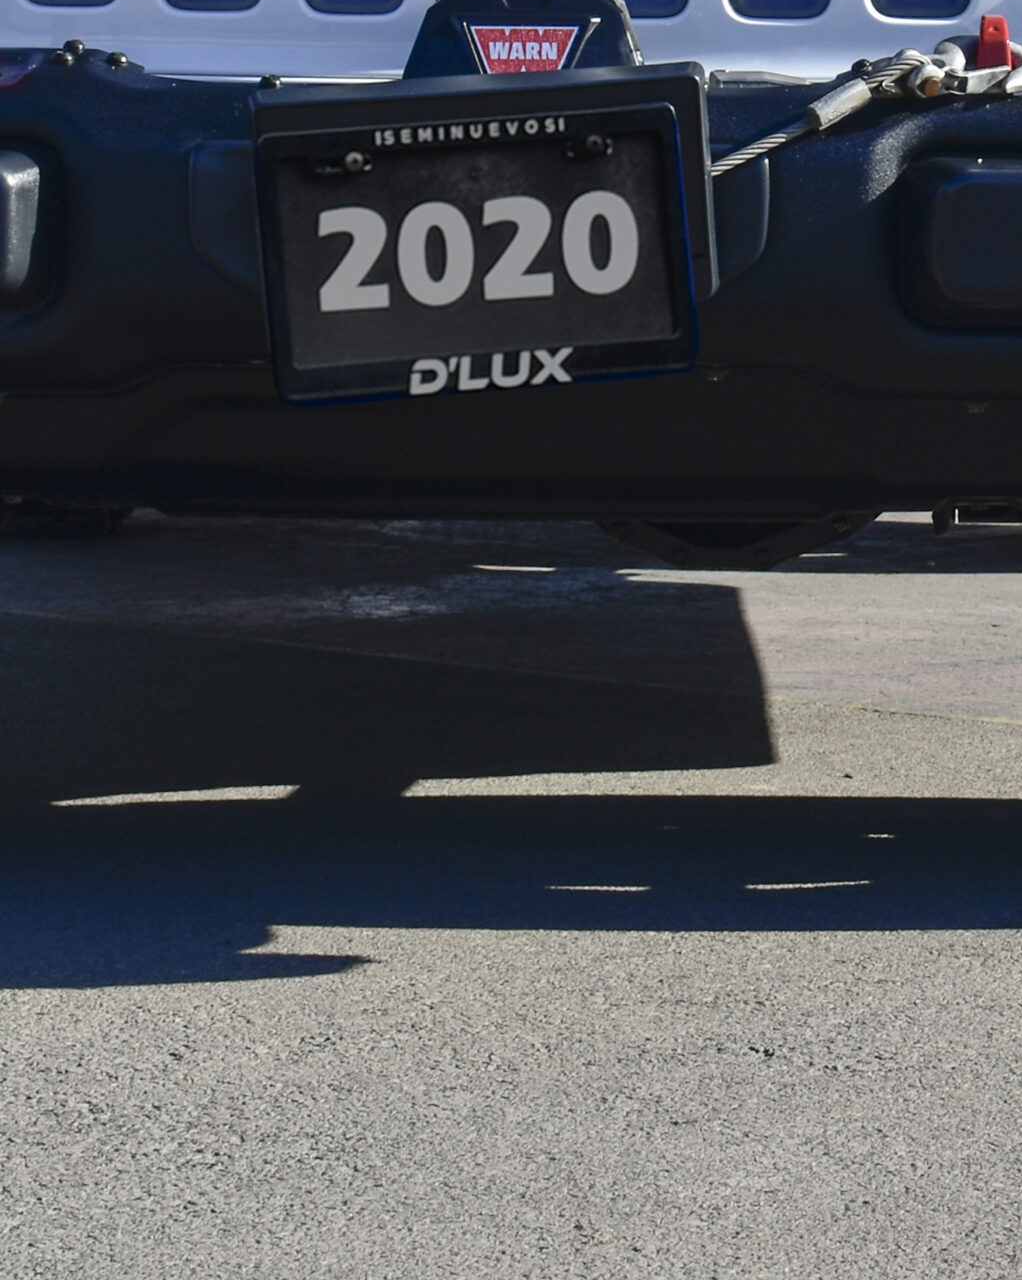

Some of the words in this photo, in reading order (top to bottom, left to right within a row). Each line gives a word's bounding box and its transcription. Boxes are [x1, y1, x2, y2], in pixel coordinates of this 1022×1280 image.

[487, 41, 558, 60] WARN
[317, 190, 640, 313] 2020
[409, 346, 574, 396] D'LUX
